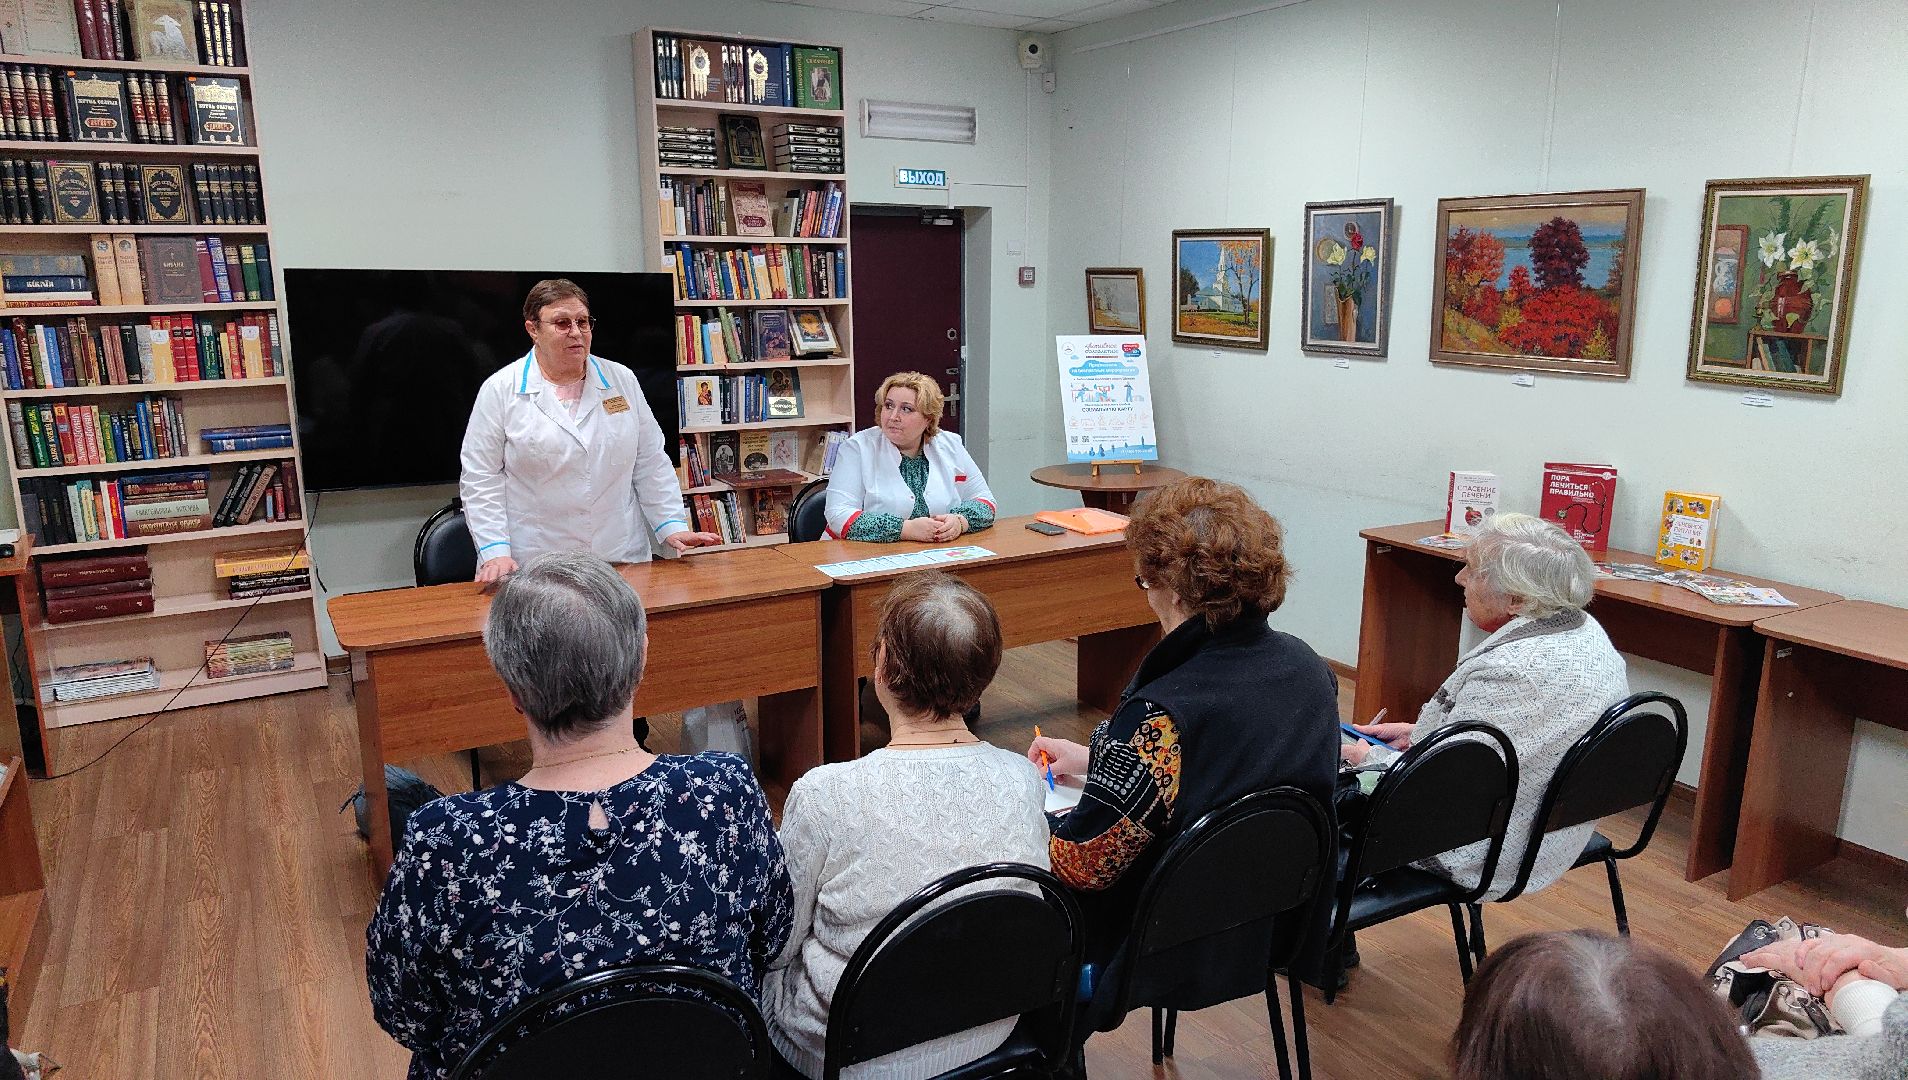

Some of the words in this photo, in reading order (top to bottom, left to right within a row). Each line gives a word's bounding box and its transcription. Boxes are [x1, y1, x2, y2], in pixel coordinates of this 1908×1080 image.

[900, 170, 944, 186] ВЫХОД
[1551, 474, 1570, 482] ПОРА
[1457, 485, 1497, 494] СПАСЕНИЕ
[1550, 481, 1589, 491] ЛЕЧИТЬСЯ
[1461, 491, 1491, 499] ПЕЧЕНИ
[1550, 488, 1595, 499] ПРАВИЛЬНО
